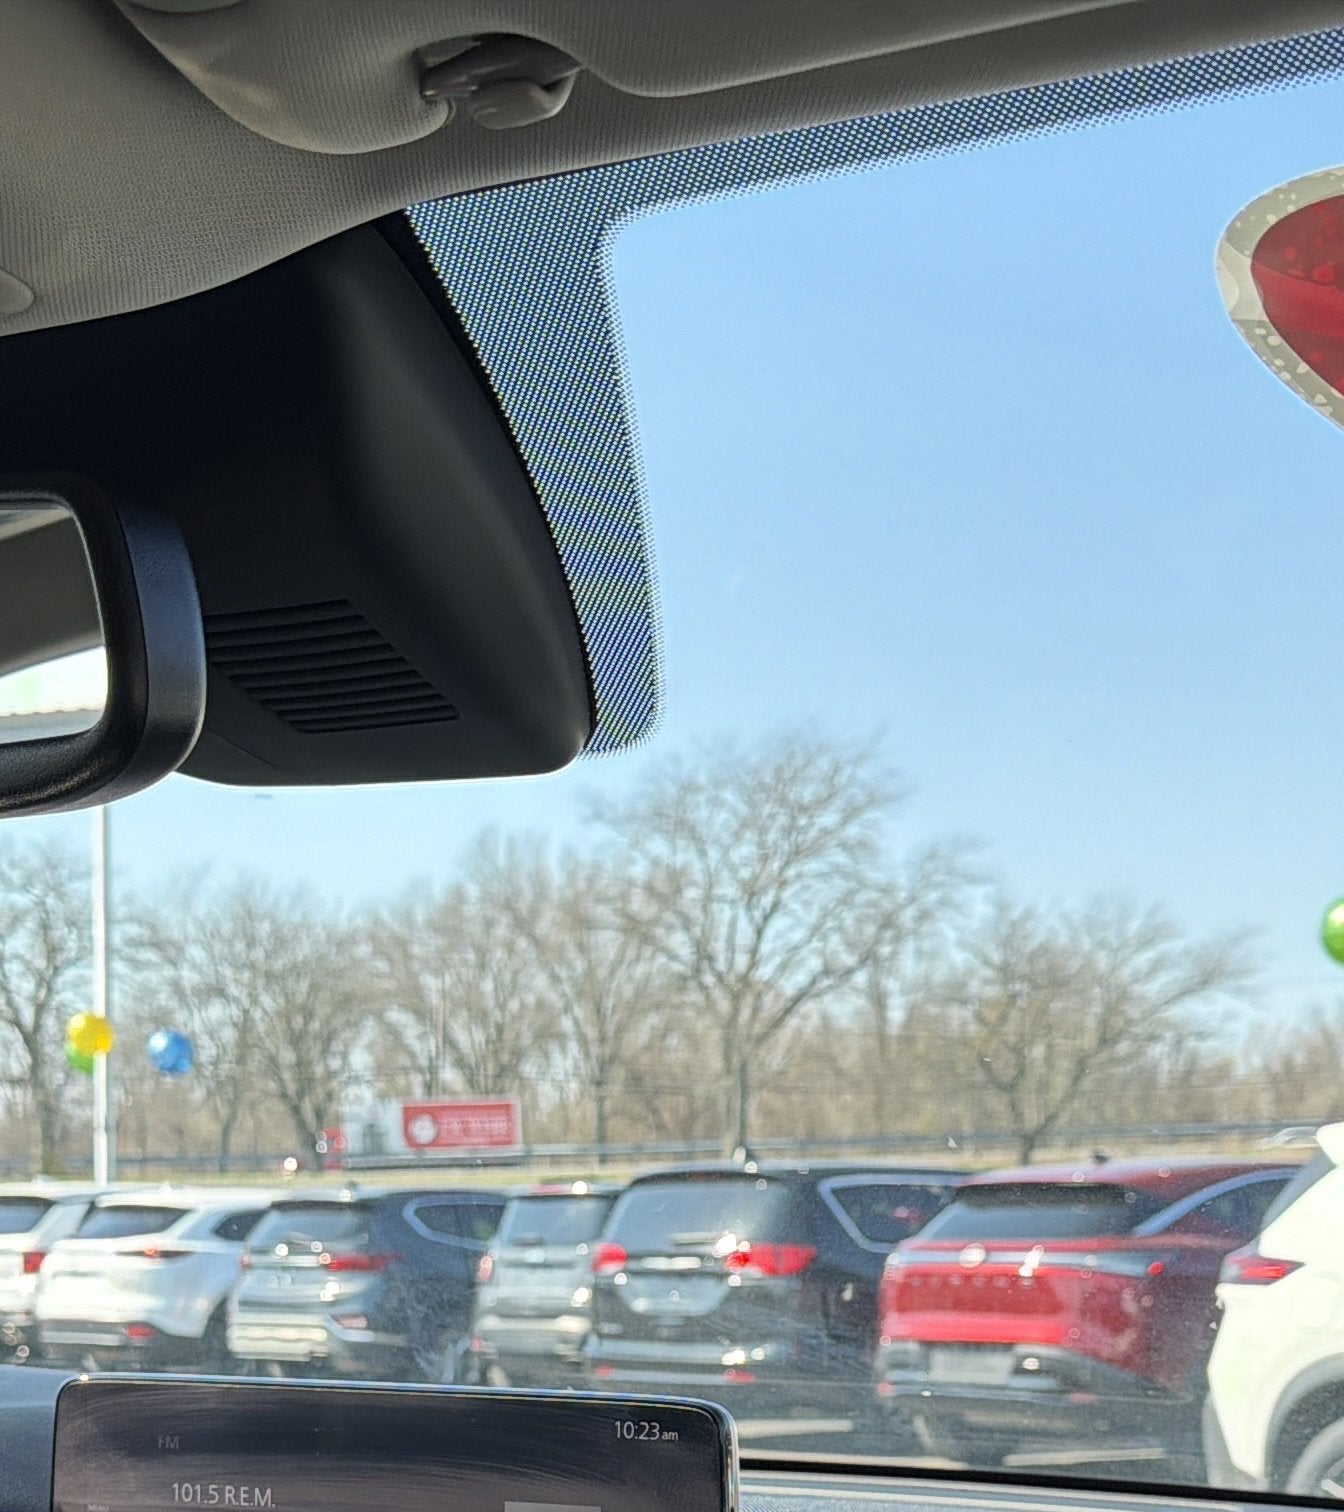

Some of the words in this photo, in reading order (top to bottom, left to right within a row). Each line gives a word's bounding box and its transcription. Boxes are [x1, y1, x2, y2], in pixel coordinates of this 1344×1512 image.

[157, 1434, 181, 1449] FM
[172, 1482, 220, 1504] 101.5
[225, 1485, 276, 1508] R.E.M.
